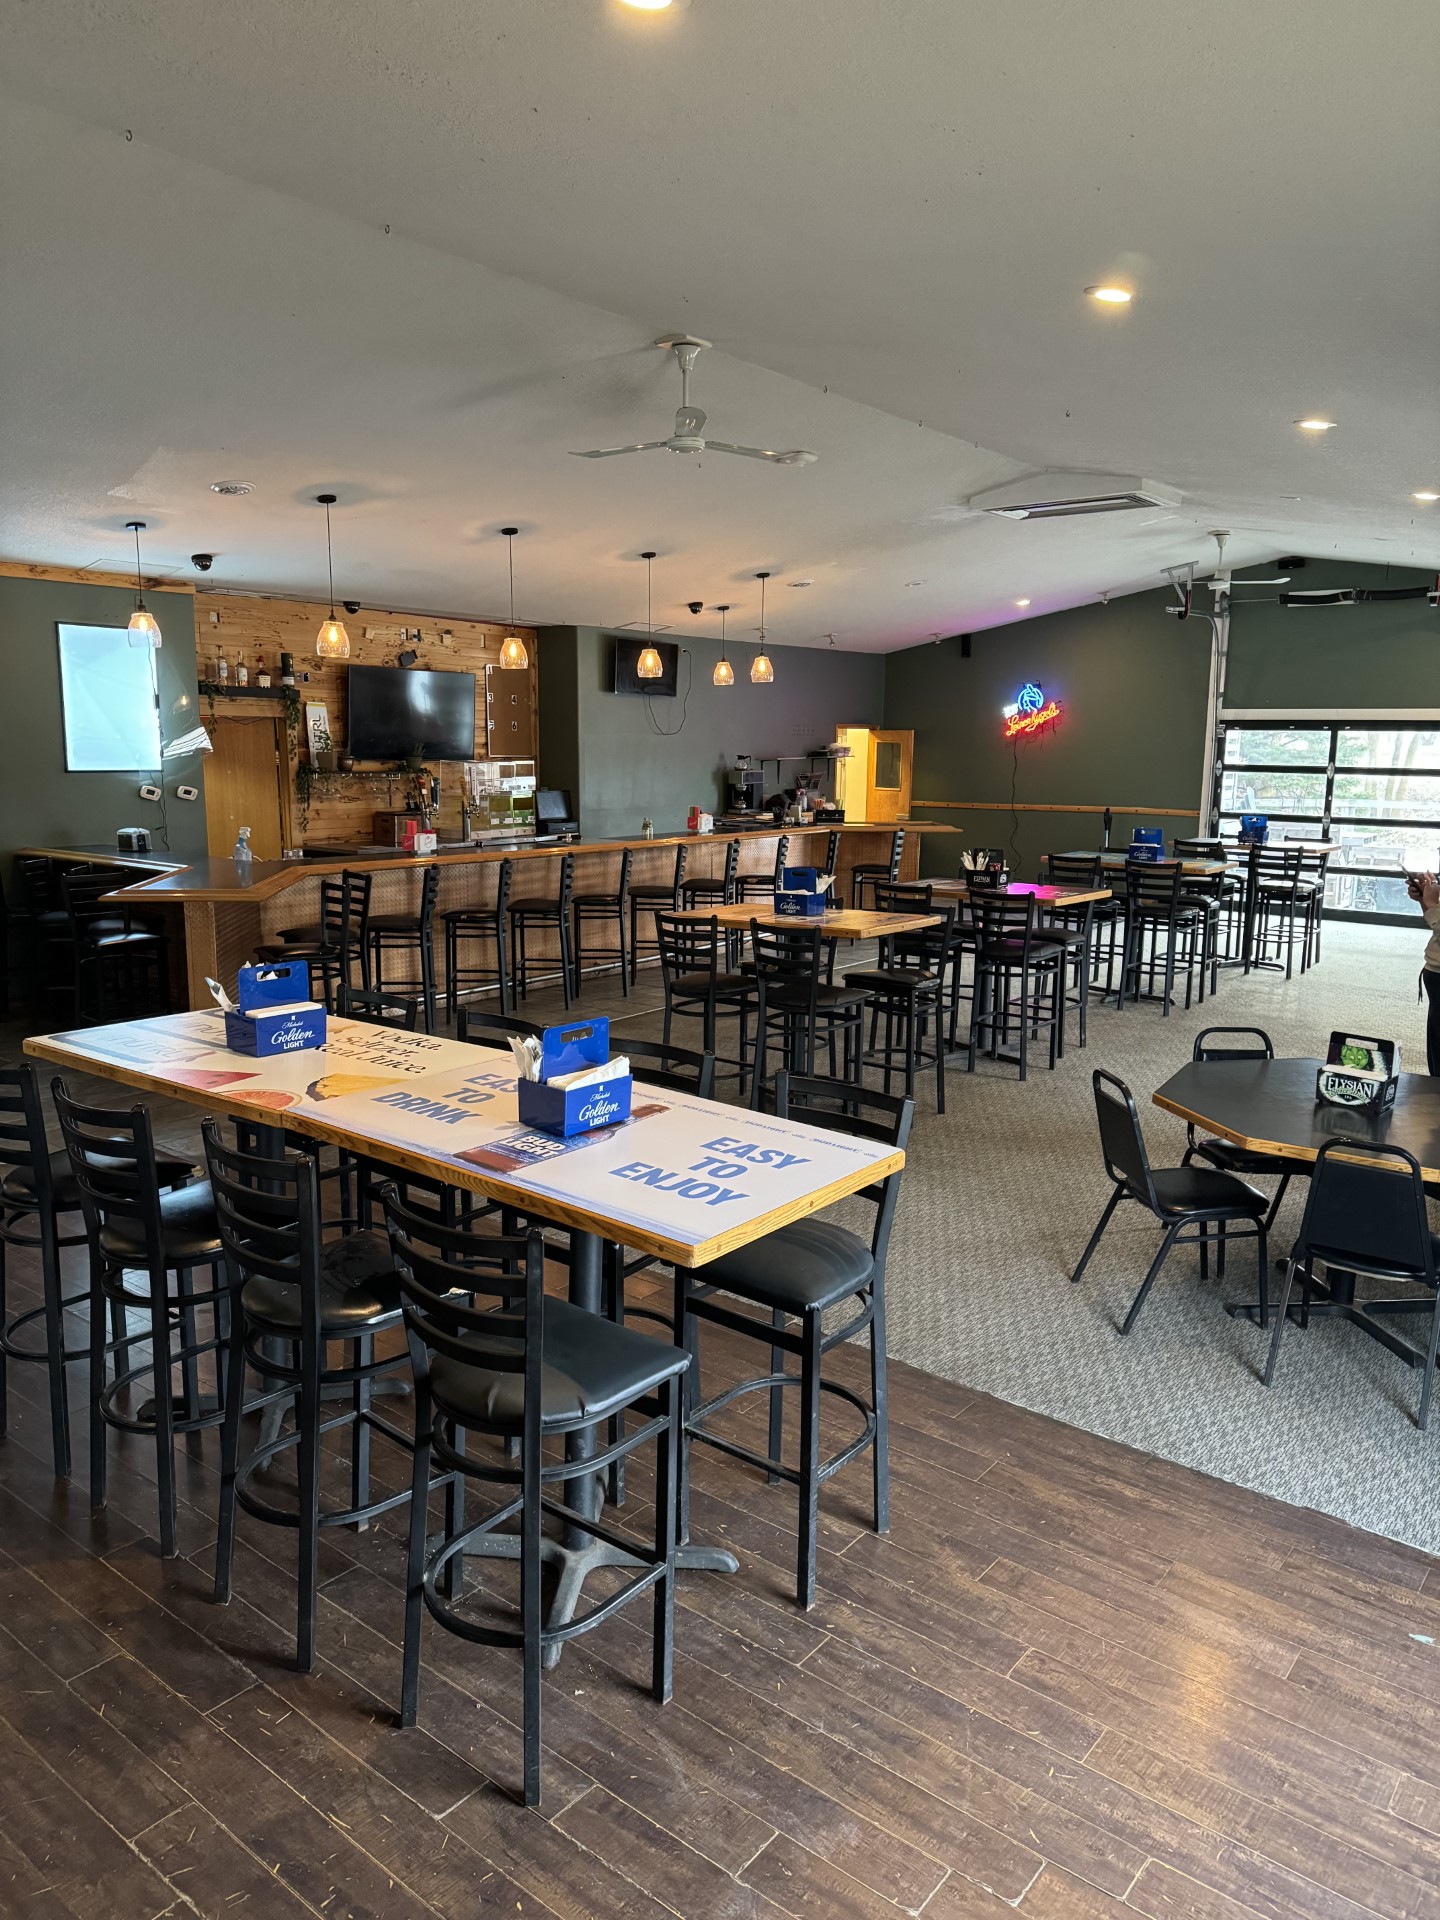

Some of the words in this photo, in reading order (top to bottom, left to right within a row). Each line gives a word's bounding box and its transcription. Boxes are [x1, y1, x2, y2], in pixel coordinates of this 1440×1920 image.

[780, 902, 802, 910] Golden
[271, 1027, 315, 1045] Golden
[283, 1040, 304, 1050] LIGHT
[463, 1073, 518, 1093] EAS
[1327, 1076, 1372, 1099] ELYSIAN
[442, 1087, 496, 1104] TO
[370, 1091, 483, 1125] DRINK
[578, 1099, 620, 1122] Golden
[590, 1114, 610, 1127] LIGHT
[499, 1139, 558, 1158] LIGHT
[519, 1136, 566, 1151] BUD
[699, 1136, 813, 1169] EASY
[687, 1155, 749, 1179] TO
[608, 1161, 751, 1206] ENJOY
